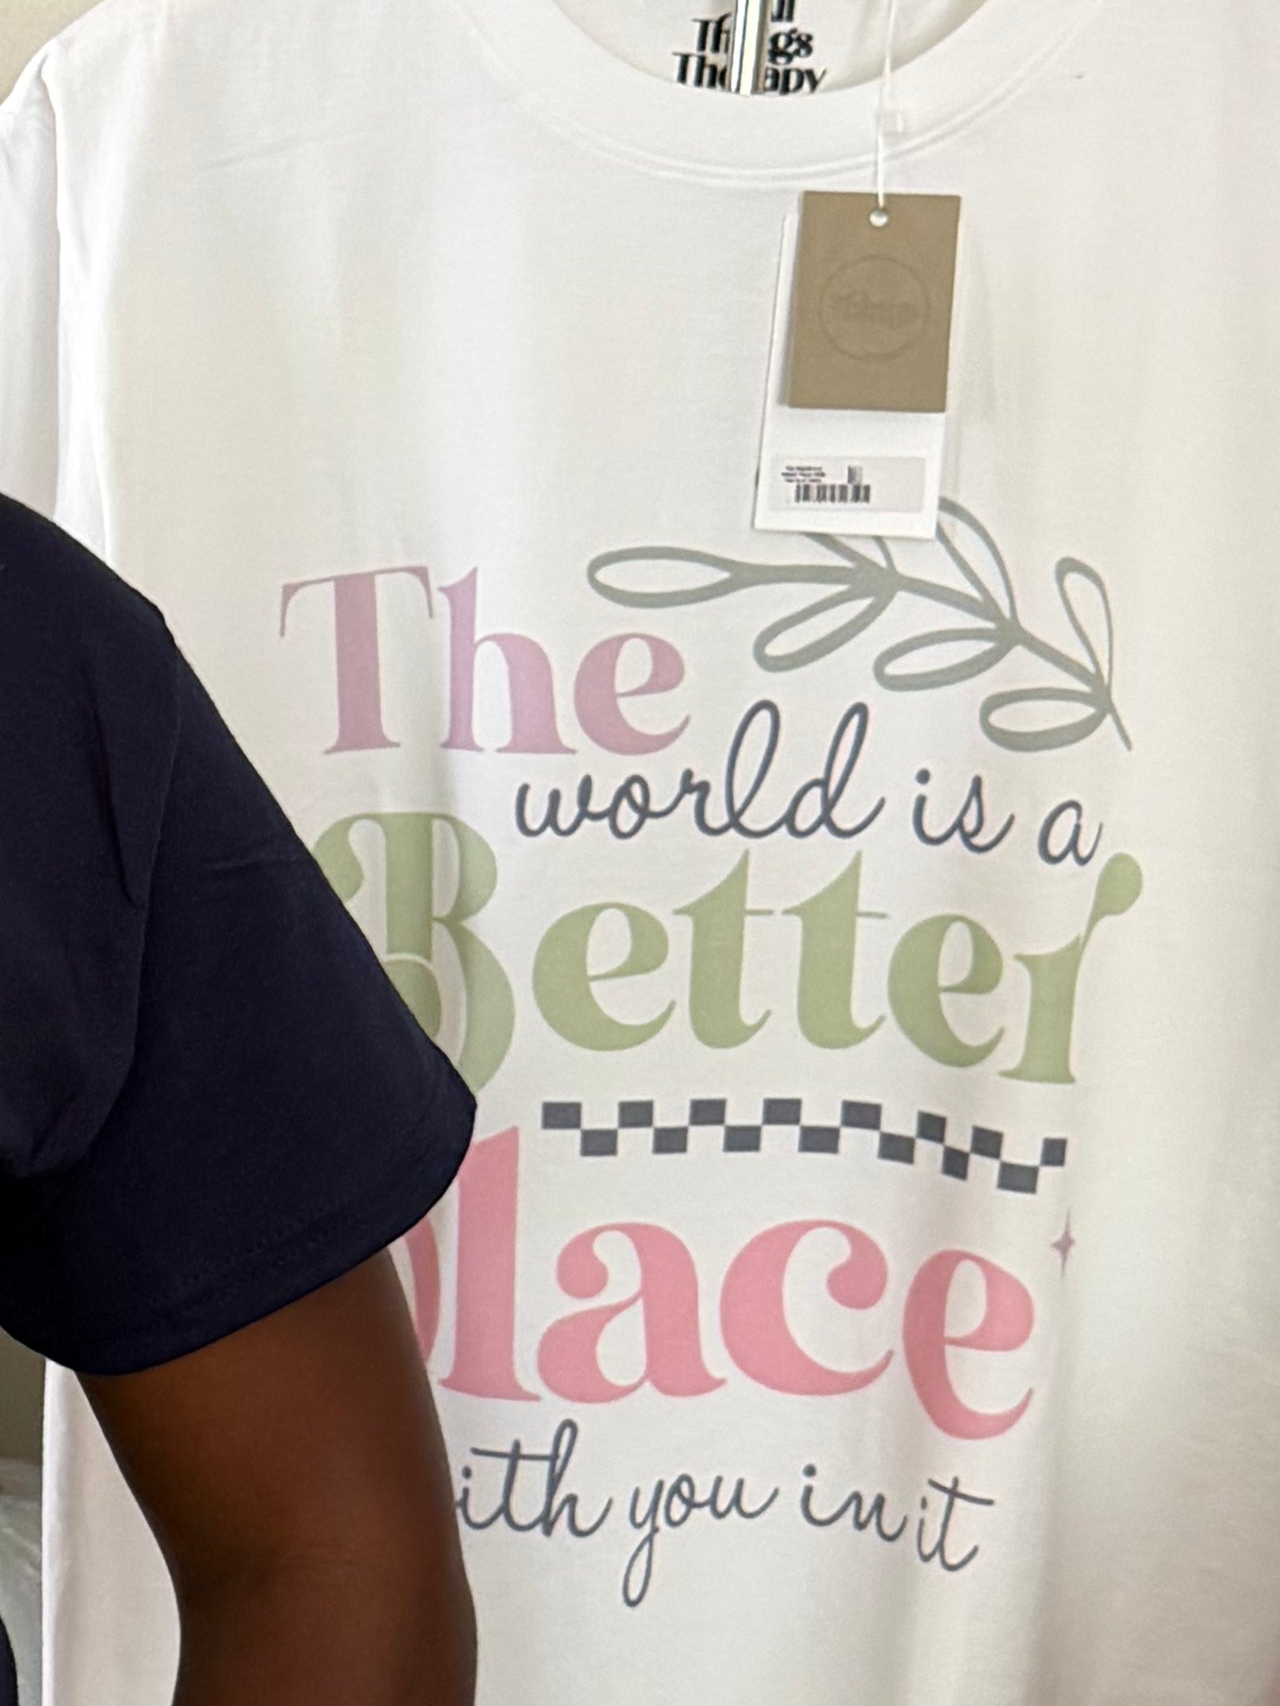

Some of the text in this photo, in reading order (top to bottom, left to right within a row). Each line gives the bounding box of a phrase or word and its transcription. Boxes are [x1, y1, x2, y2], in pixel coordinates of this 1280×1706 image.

[672, 51, 827, 95] Thapy
[692, 13, 813, 66] Thgs
[280, 565, 692, 757] The
[515, 699, 1104, 866] world is a
[312, 810, 1144, 1097] Better
[390, 1125, 1036, 1441] lace
[454, 1419, 996, 1608] ith you in it
